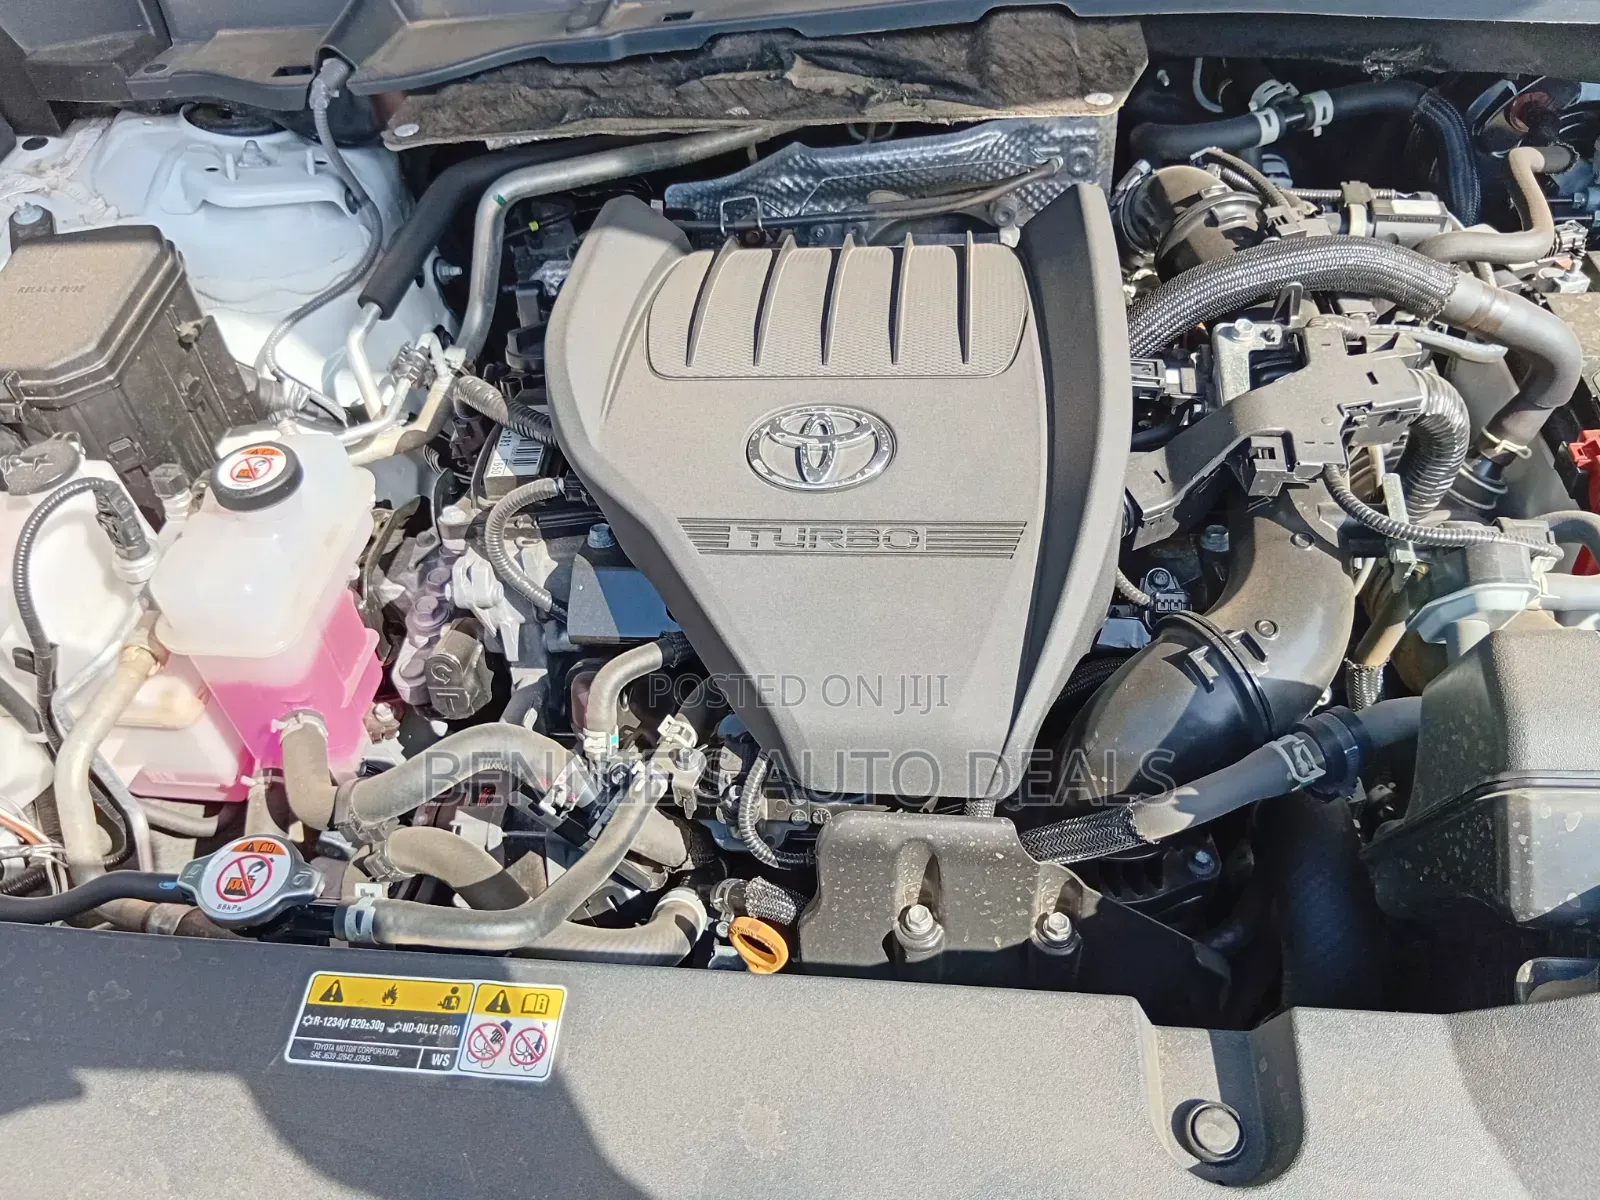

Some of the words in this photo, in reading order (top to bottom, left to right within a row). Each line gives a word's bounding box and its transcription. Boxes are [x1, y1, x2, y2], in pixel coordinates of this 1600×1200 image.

[736, 527, 919, 549] TURBO
[309, 1051, 322, 1059] SAE
[313, 1042, 335, 1052] TOYOTA
[335, 1044, 357, 1053] MOTOR
[357, 1045, 400, 1057] CORPORATION
[431, 1053, 451, 1067] WS
